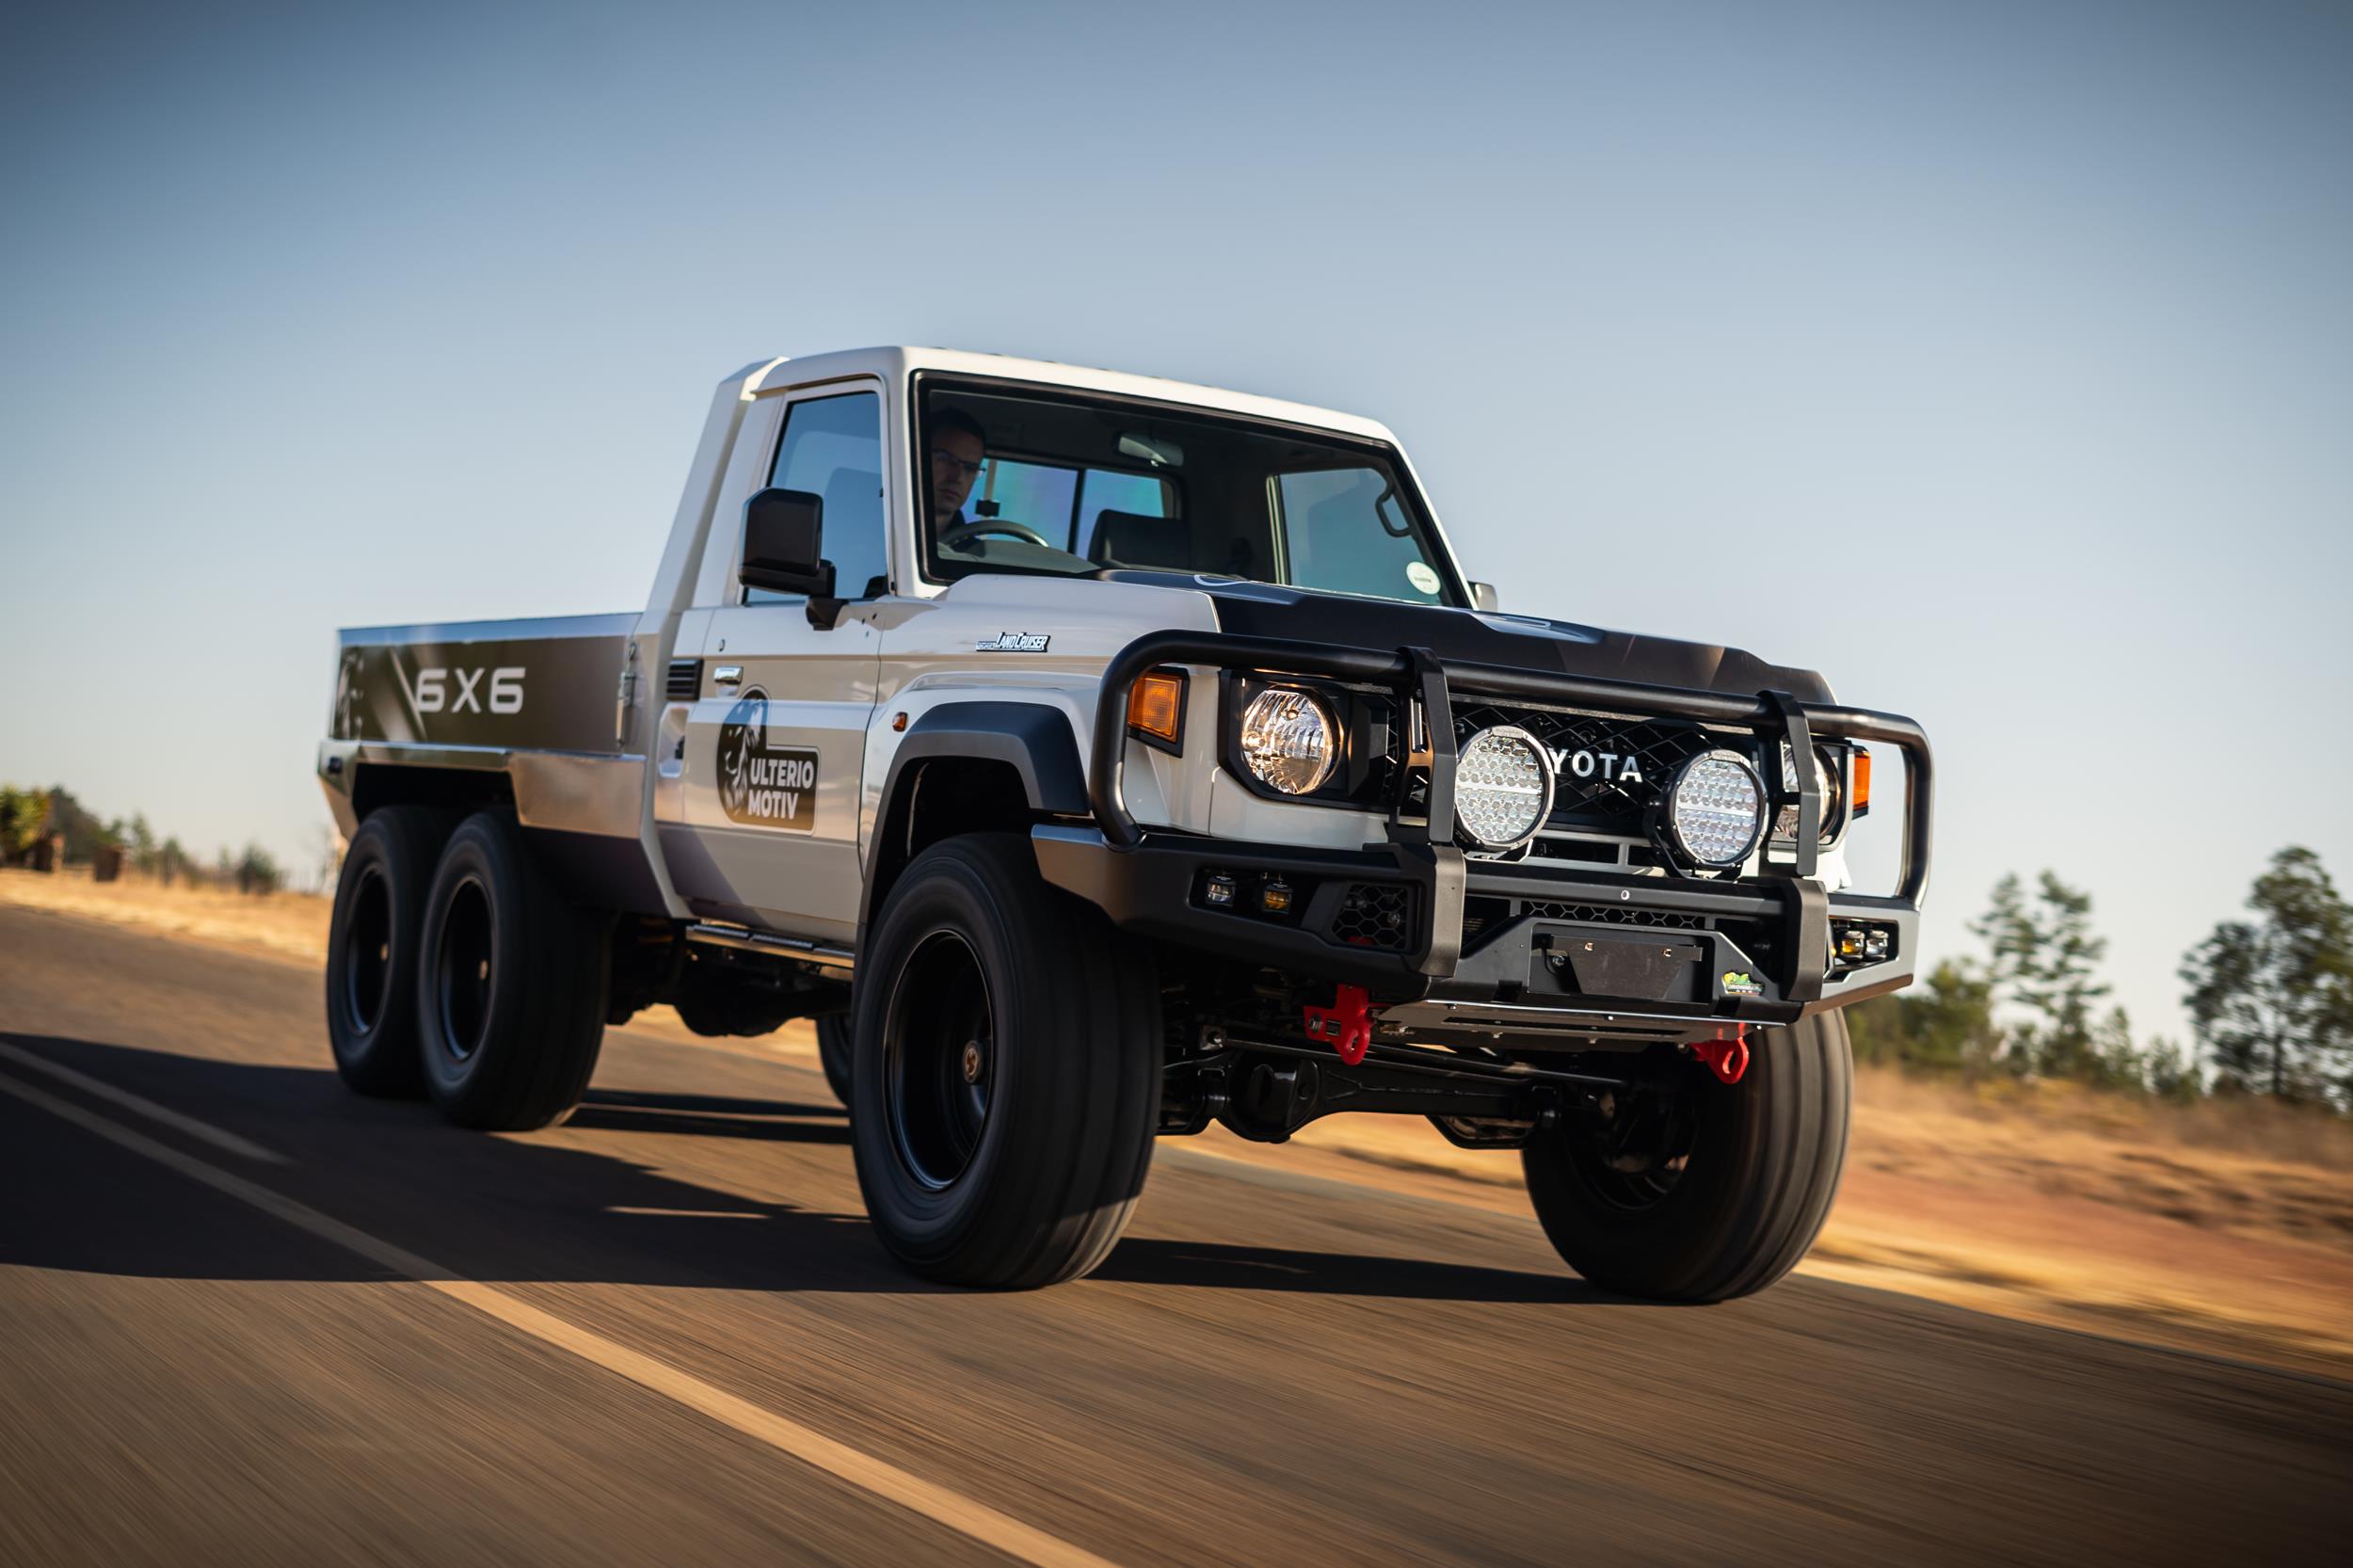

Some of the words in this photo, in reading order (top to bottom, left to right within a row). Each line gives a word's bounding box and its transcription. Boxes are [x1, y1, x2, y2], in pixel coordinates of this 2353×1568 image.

[415, 667, 526, 714] 6X6
[750, 758, 815, 789] ULTERIO
[1547, 747, 1642, 783] YOTA
[747, 789, 799, 820] MOTIV
